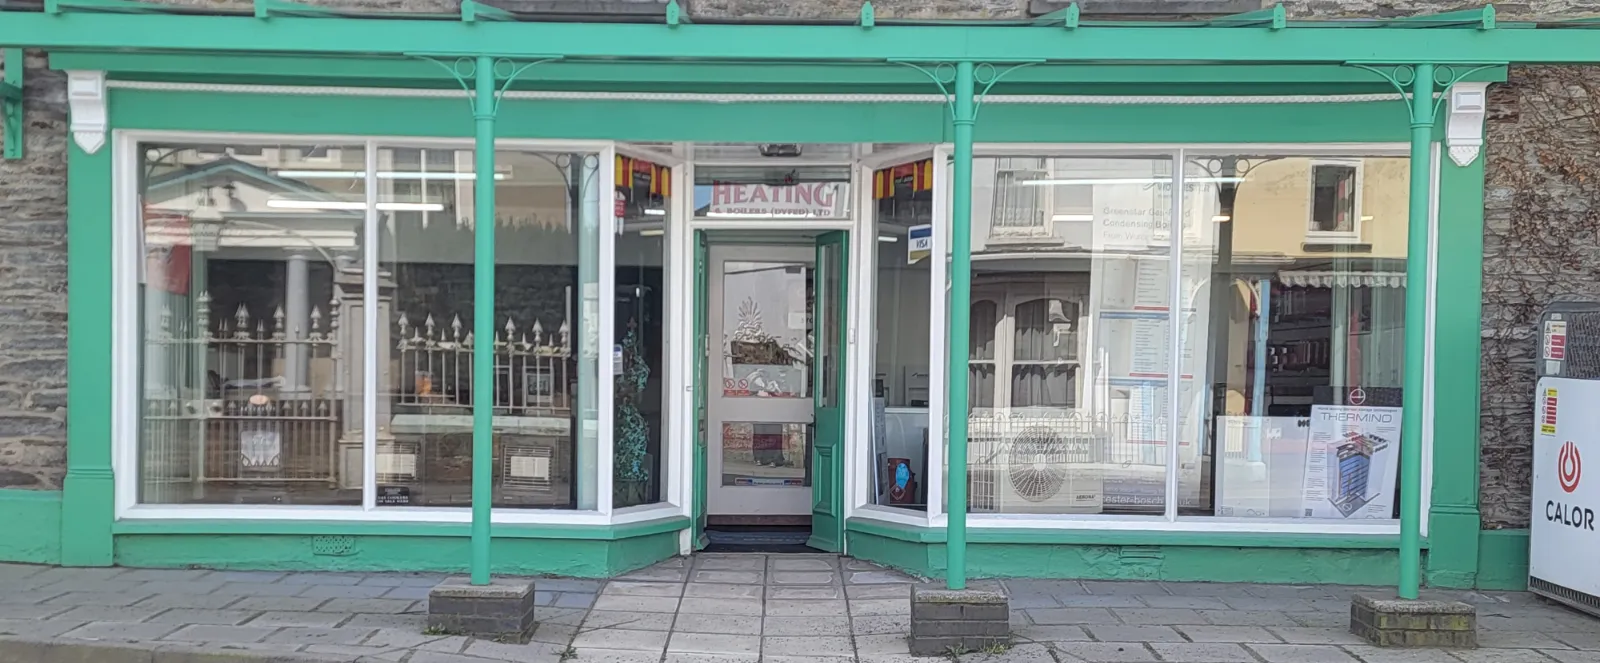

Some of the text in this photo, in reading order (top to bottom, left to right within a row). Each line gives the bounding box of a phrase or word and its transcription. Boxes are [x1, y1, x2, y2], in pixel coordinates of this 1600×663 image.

[713, 180, 833, 208] HEATING
[726, 207, 767, 215] BOILERS
[770, 207, 809, 218] (DYFED)
[813, 208, 831, 217] LTD
[1103, 206, 1146, 217] Greenstar
[1103, 218, 1153, 230] Condensing
[916, 239, 928, 249] VISA
[1321, 412, 1393, 424] THERMINO
[1545, 499, 1595, 532] CALOR
